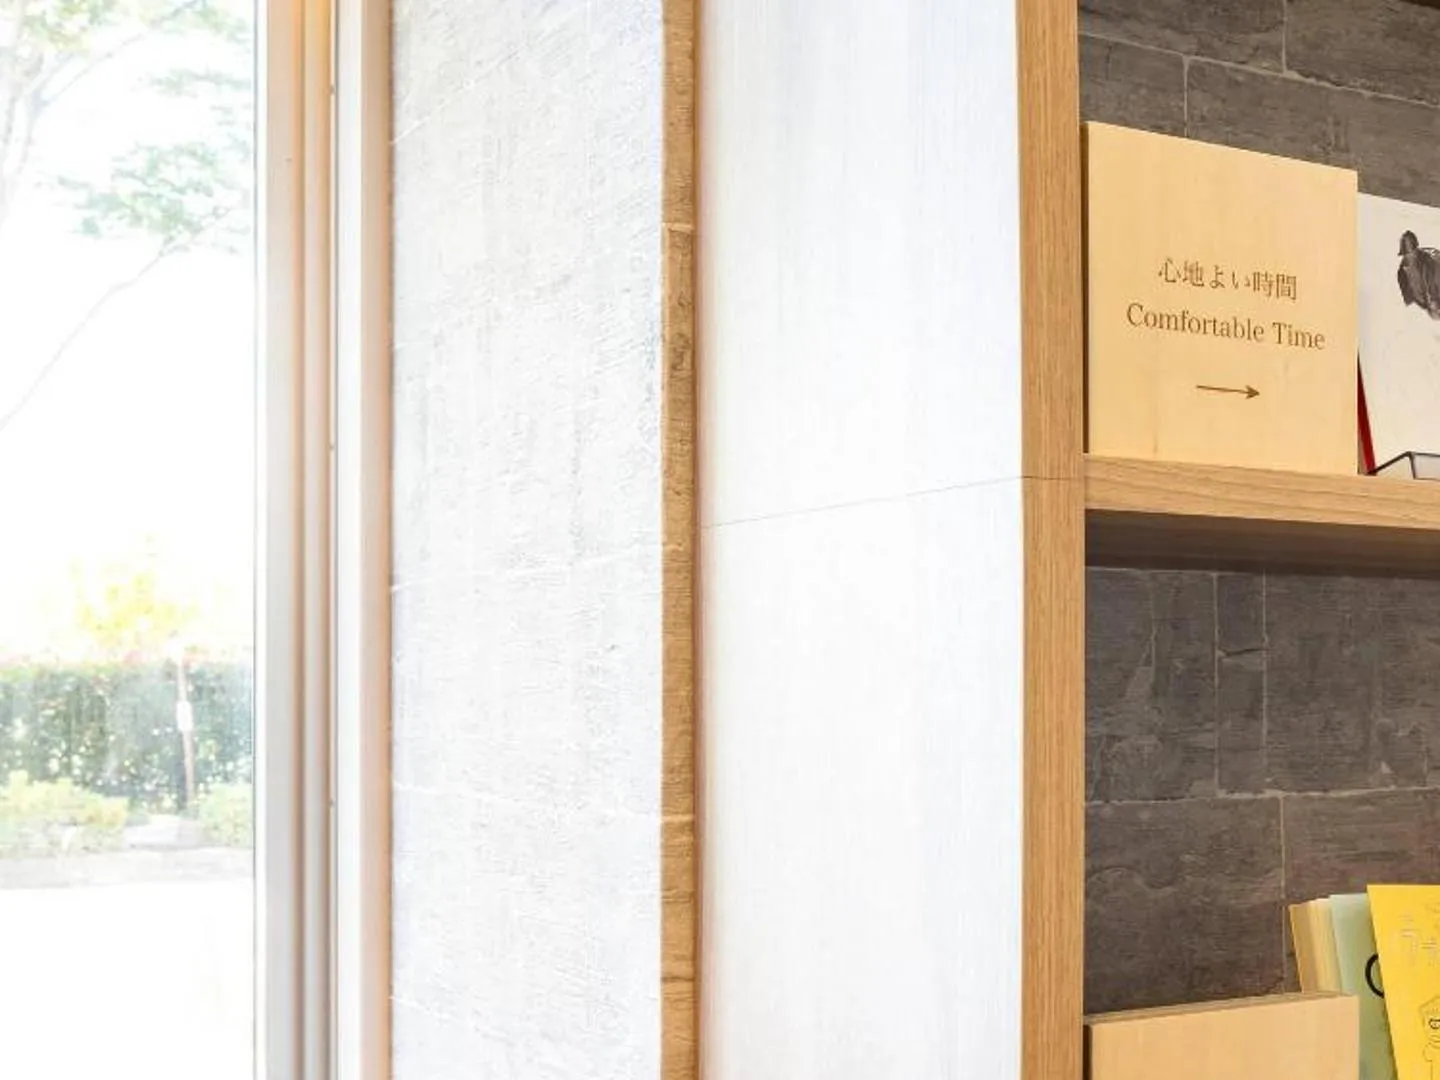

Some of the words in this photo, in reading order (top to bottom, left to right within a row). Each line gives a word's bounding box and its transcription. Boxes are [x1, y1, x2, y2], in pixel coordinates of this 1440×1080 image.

[1158, 257, 1298, 301] 心地よい時間
[1126, 303, 1265, 343] Comfortable
[1271, 322, 1327, 351] Time
